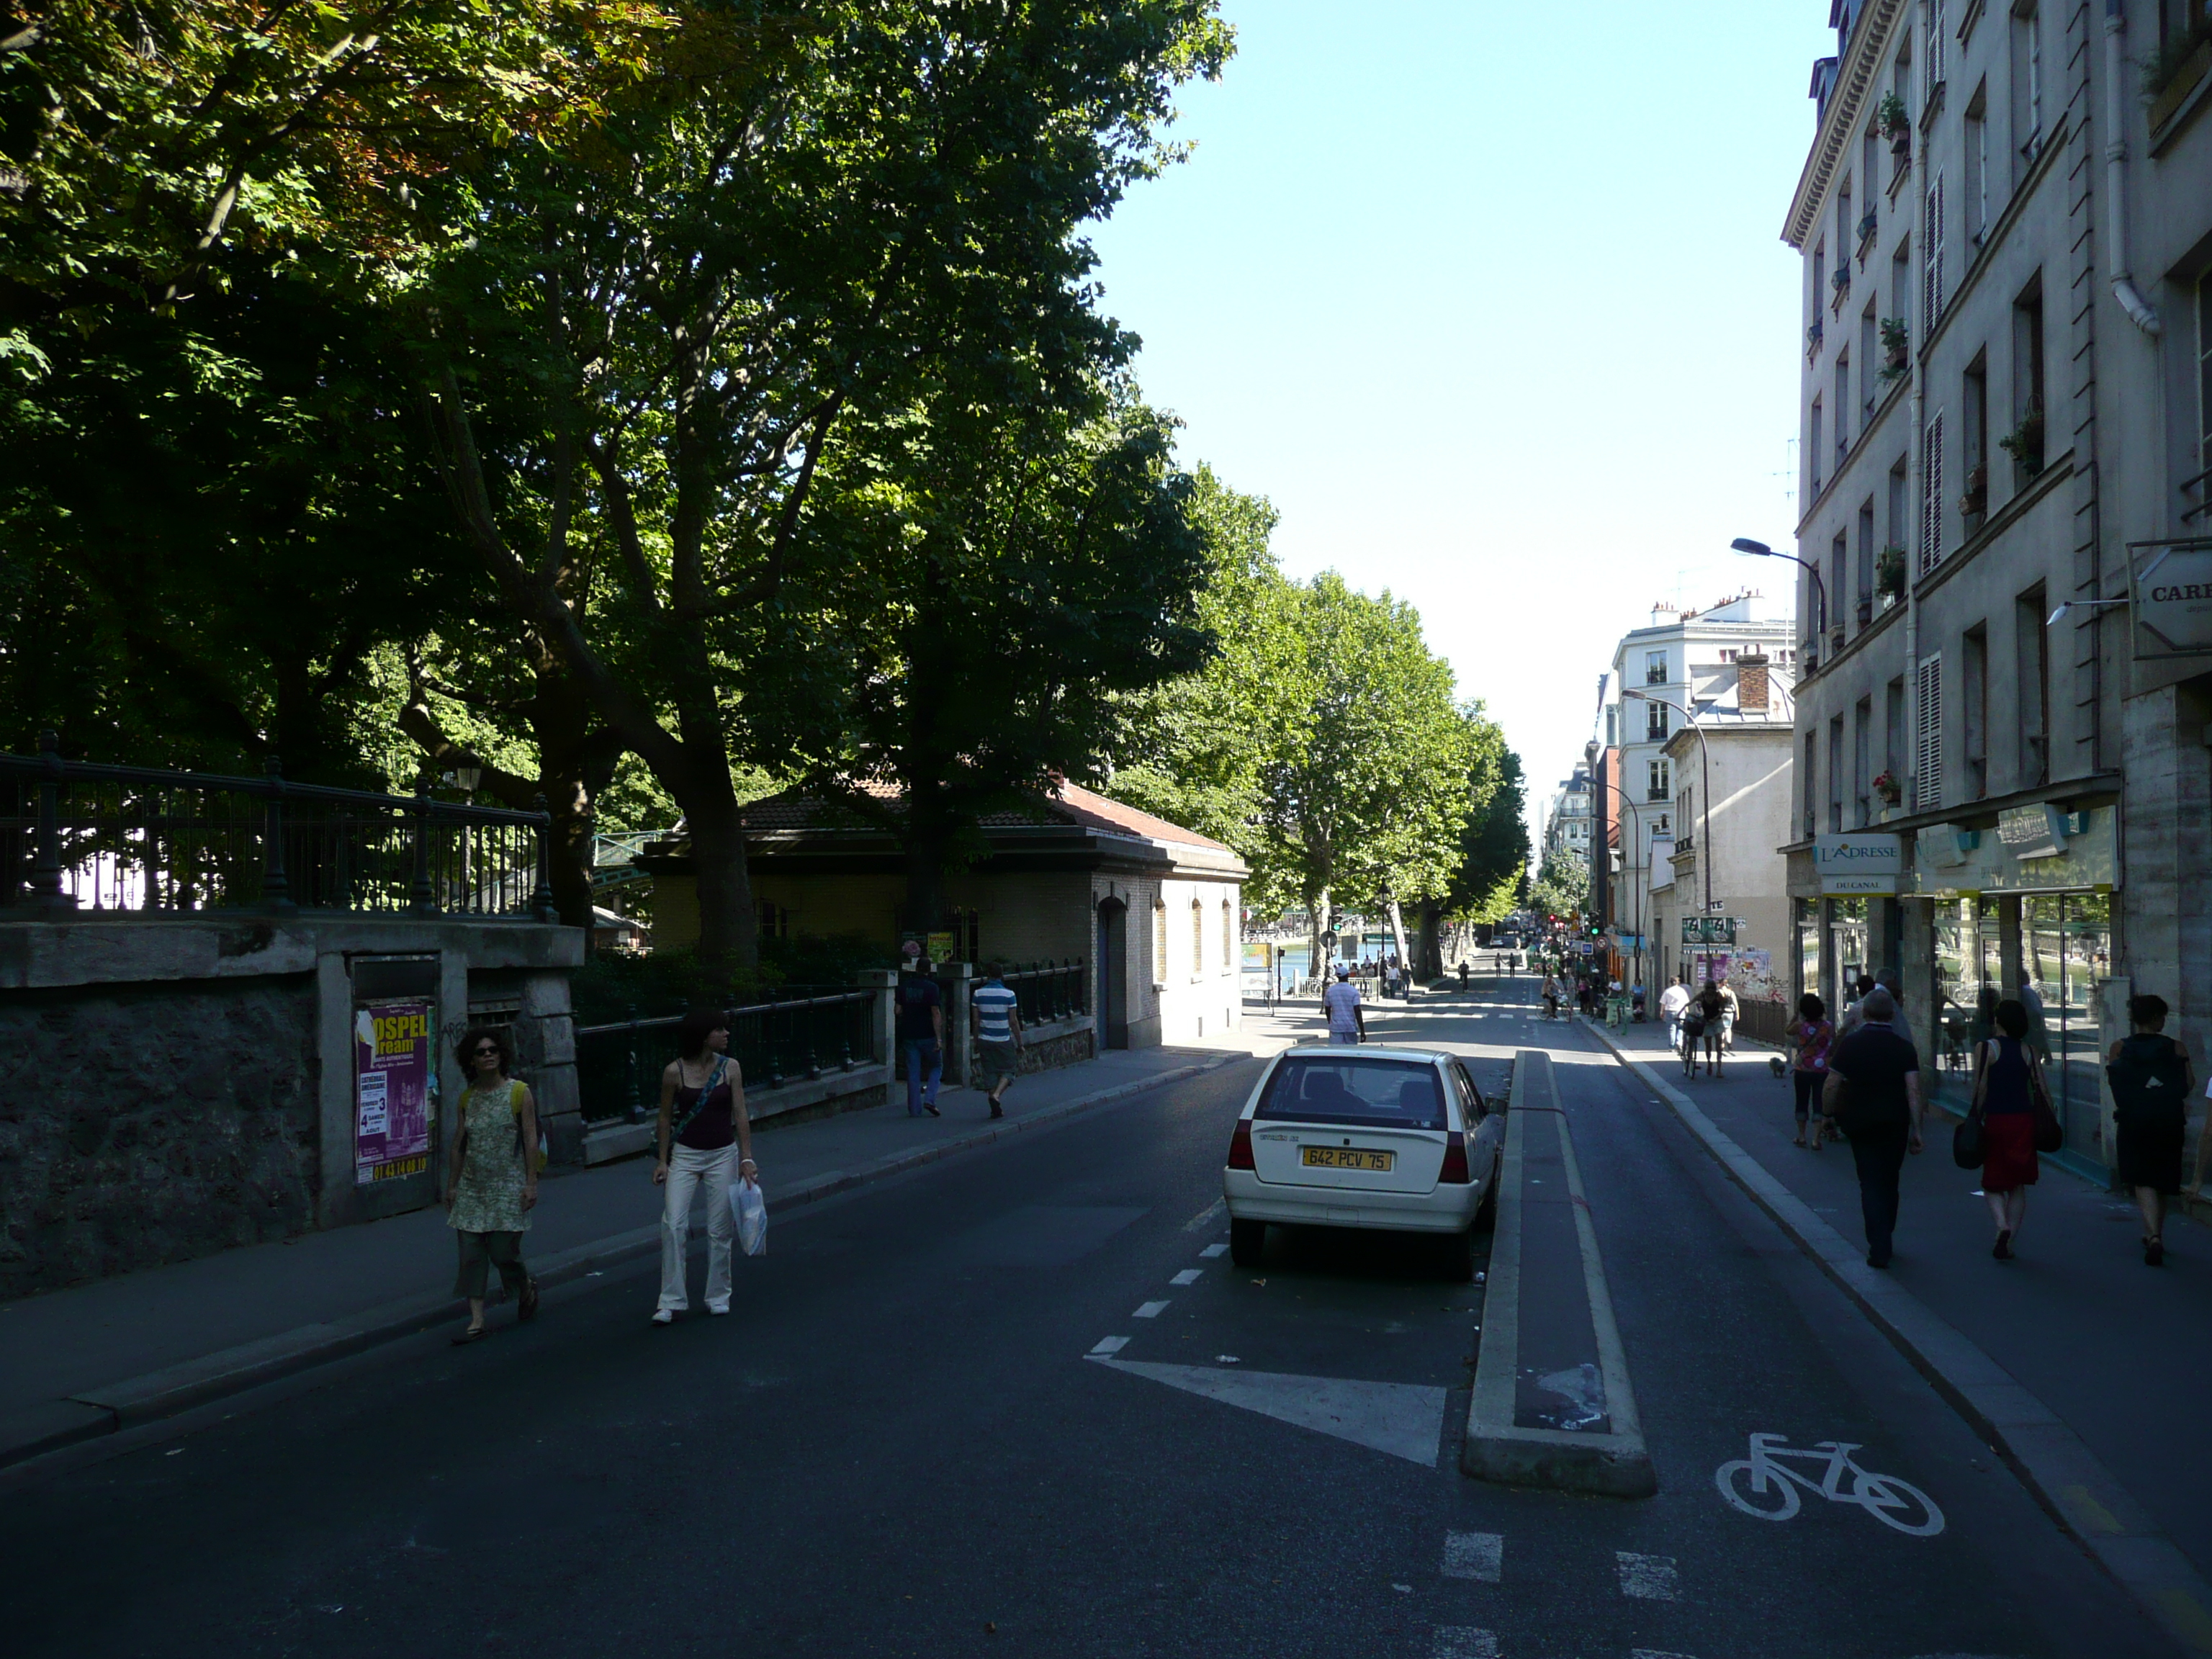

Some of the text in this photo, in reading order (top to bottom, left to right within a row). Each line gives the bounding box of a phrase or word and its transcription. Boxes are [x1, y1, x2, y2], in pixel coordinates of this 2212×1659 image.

[1822, 847, 1897, 862] L'ADRESSE
[359, 1015, 428, 1043] OSPEL
[379, 1097, 385, 1110] 3
[361, 1115, 368, 1128] 4
[1310, 1150, 1384, 1169] 642 PCV 75
